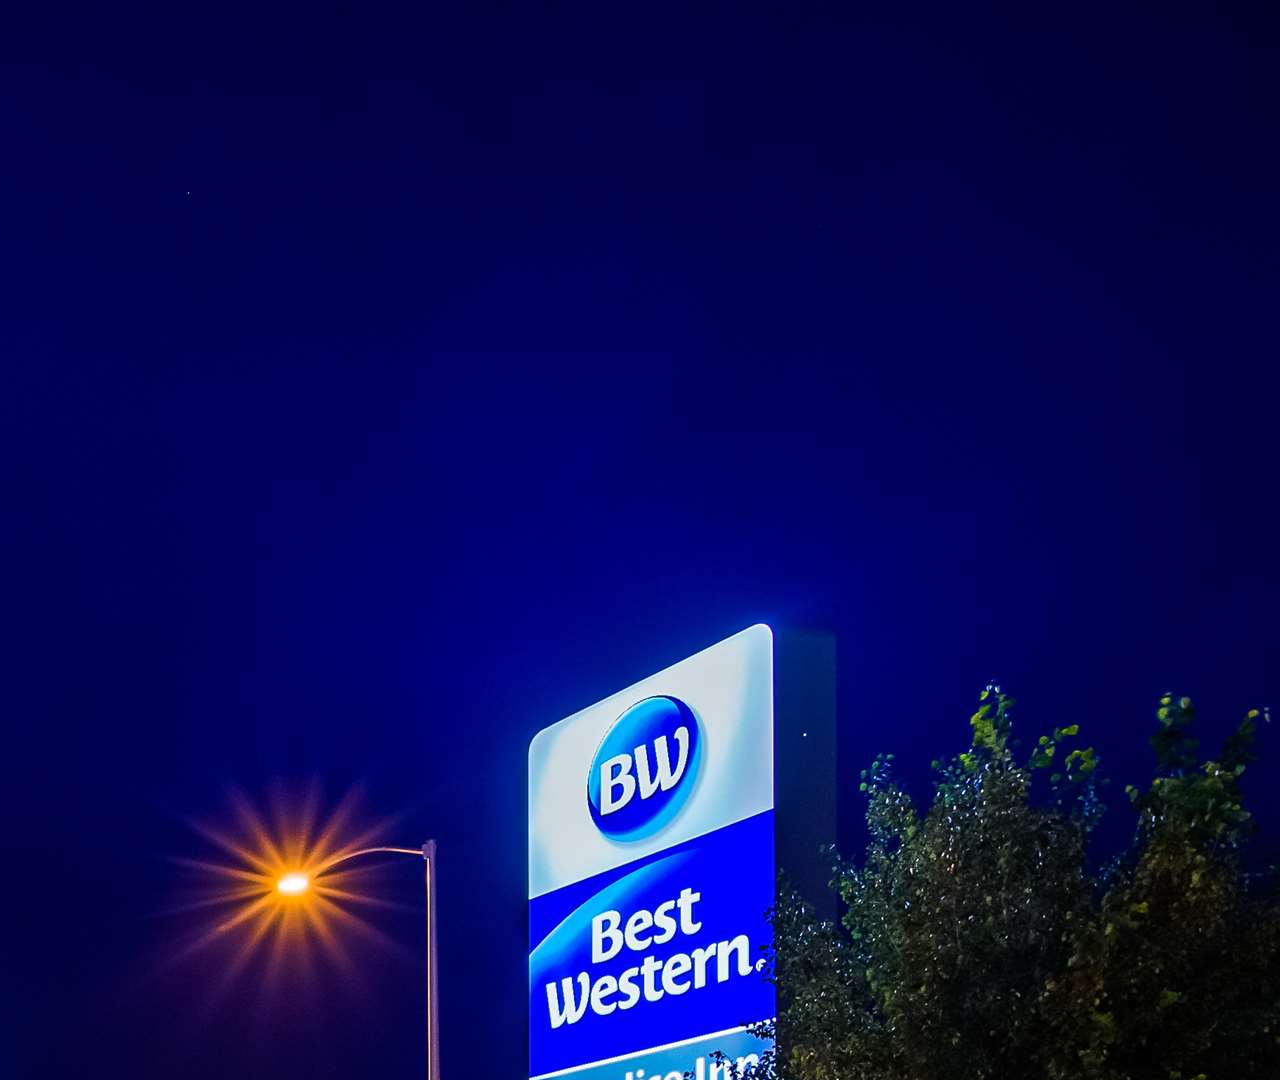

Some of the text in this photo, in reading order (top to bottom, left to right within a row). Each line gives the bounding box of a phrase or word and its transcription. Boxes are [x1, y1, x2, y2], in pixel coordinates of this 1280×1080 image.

[600, 726, 689, 816] BW
[592, 888, 702, 964] Best
[546, 935, 753, 1029] Western
